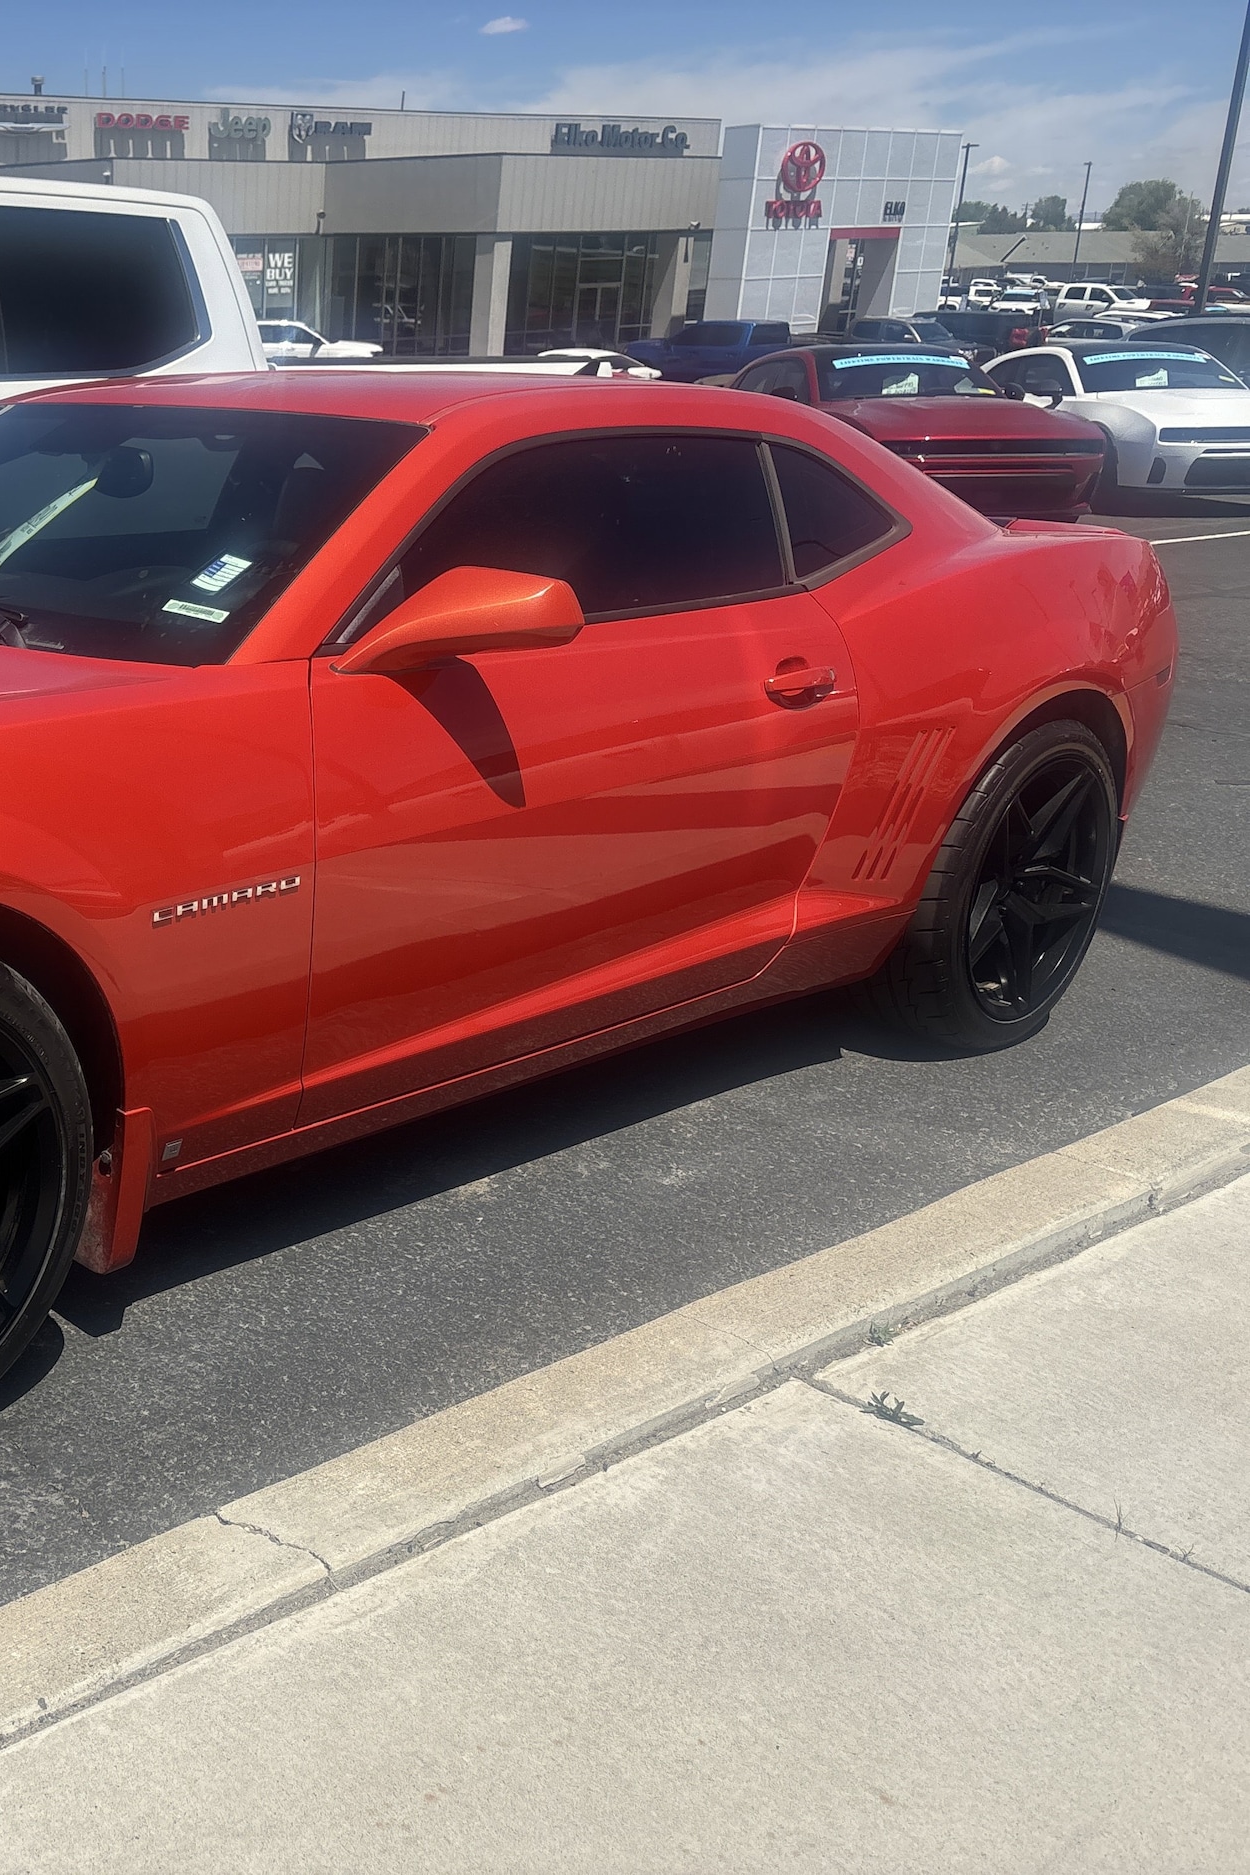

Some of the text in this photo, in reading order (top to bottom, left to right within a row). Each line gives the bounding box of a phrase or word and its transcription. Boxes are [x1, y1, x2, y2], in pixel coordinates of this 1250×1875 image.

[96, 112, 190, 130] DODGE
[210, 108, 271, 143] Jeep
[314, 121, 373, 136] RAM
[555, 123, 599, 147] Elko
[600, 124, 660, 148] Motor
[765, 200, 822, 218] TOYOTA
[884, 201, 906, 216] ELKO
[268, 253, 293, 268] WE
[266, 268, 294, 280] BUY
[152, 875, 301, 923] CAMARO
